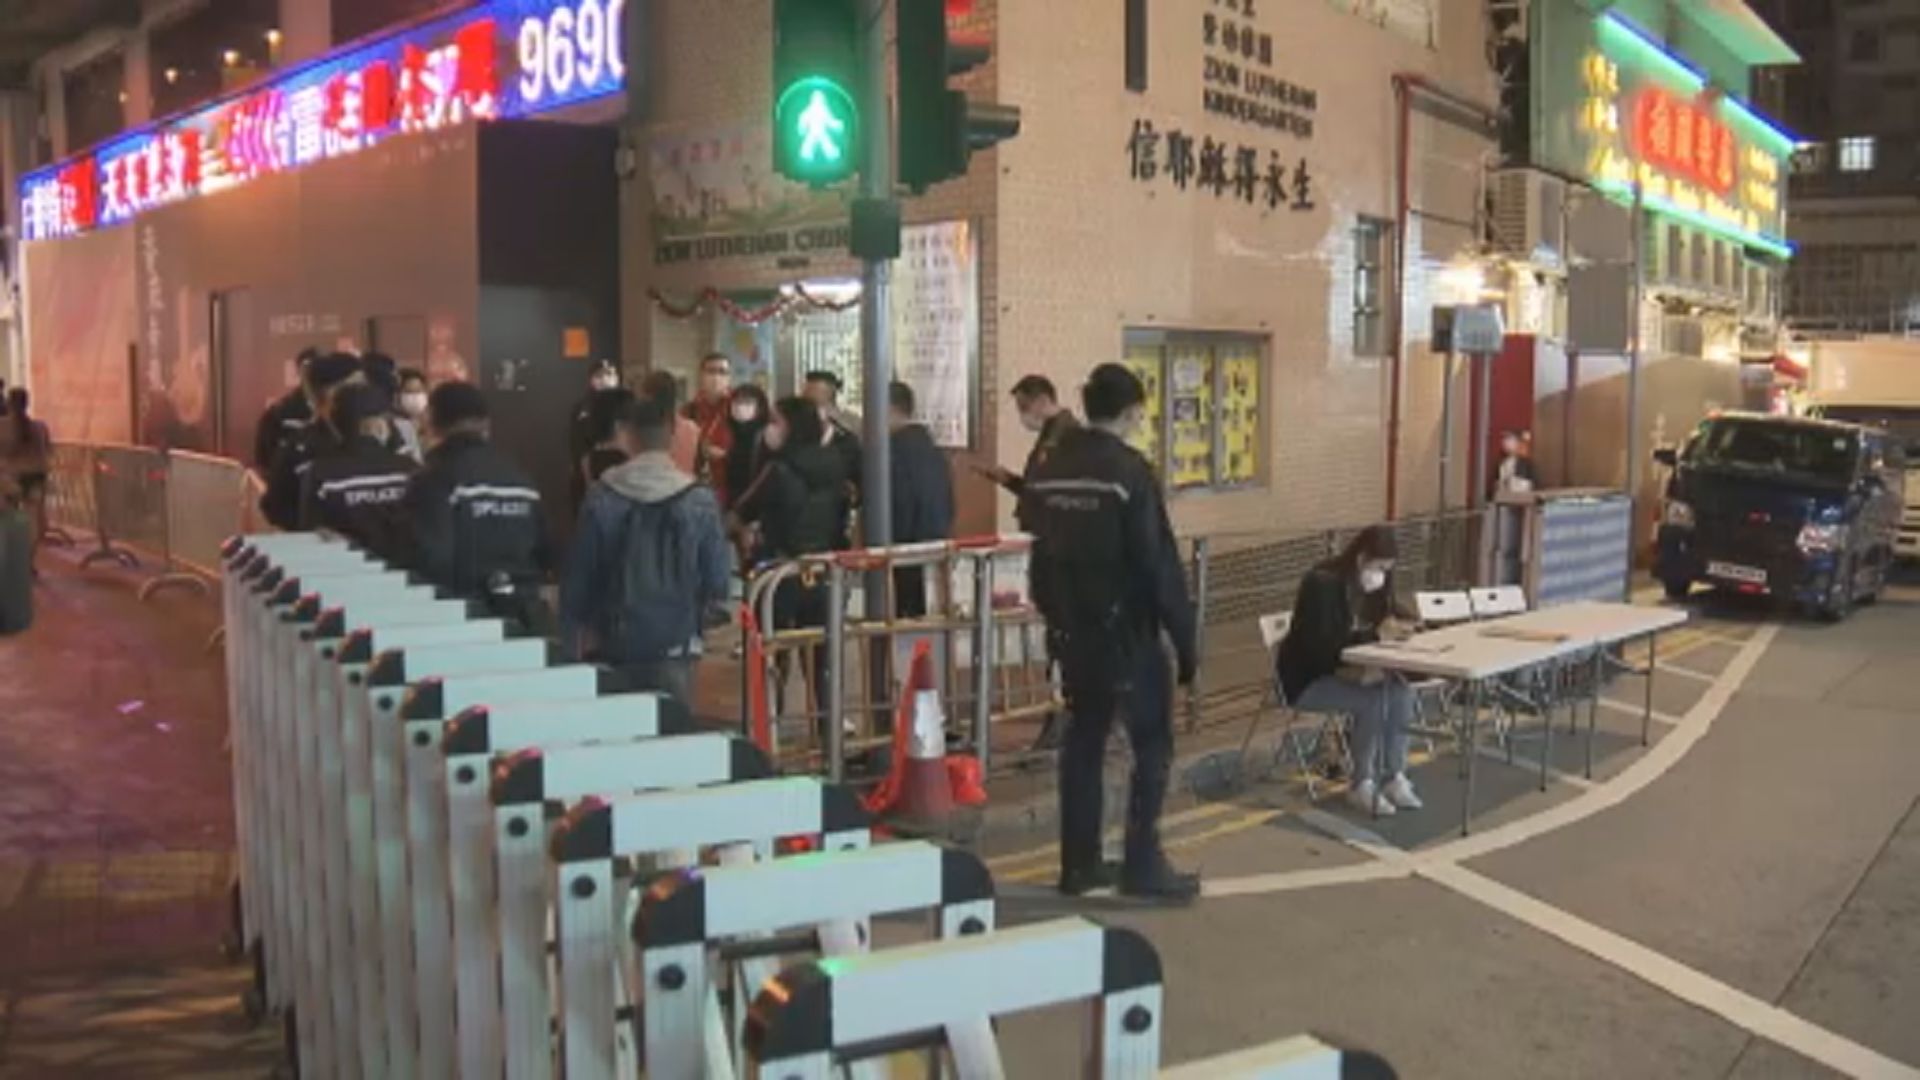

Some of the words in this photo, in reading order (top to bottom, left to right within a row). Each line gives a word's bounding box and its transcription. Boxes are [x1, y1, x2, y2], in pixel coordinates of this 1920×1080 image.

[1203, 55, 1240, 87] ZION
[1244, 69, 1317, 110] LUTHERAN
[1203, 86, 1314, 140] KINDERGARTEN
[1126, 117, 1315, 210] 信耶穌得永生
